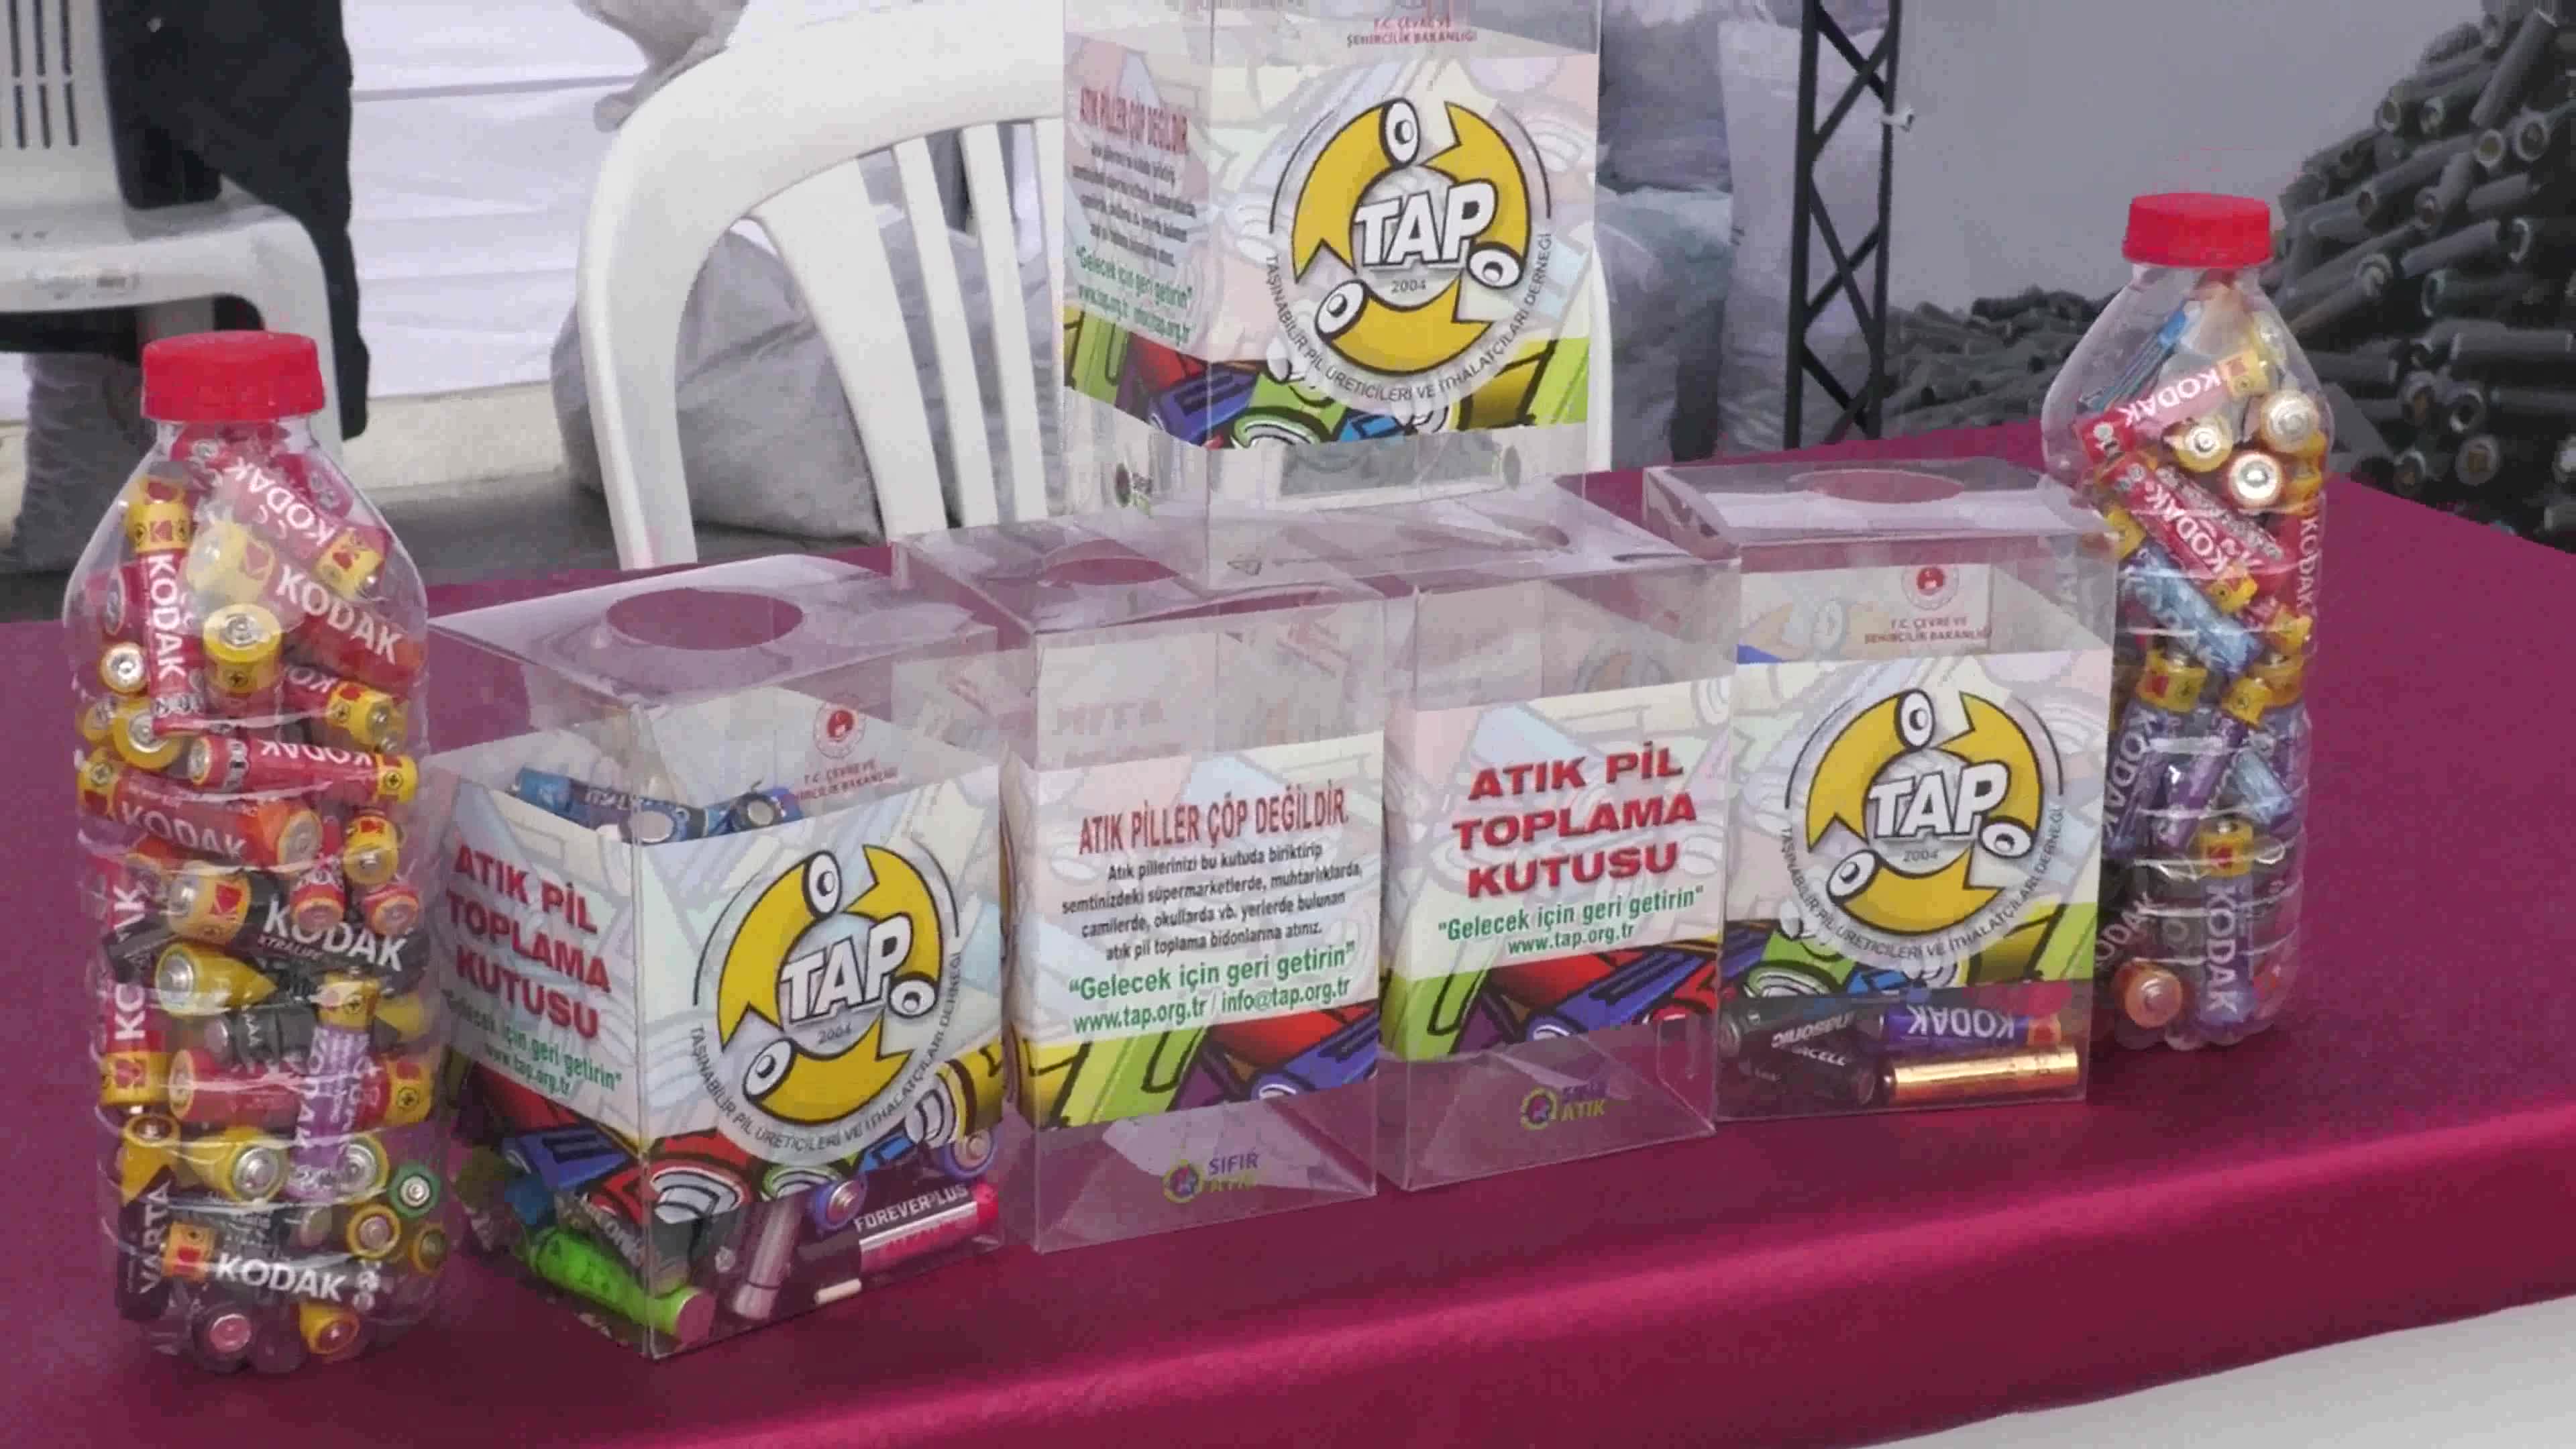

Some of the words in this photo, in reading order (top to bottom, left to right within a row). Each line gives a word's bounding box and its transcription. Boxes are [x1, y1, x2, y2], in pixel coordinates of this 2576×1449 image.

[1354, 178, 1497, 266] TAP
[1391, 278, 1428, 294] 2004
[1416, 385, 1437, 399] VE
[2117, 367, 2222, 427] KODAK
[225, 455, 337, 548] KODAK
[2295, 517, 2322, 611] KODAK
[146, 553, 186, 683] KODAK
[274, 562, 407, 668] KODAK
[1468, 755, 1587, 801] ATIK
[1605, 740, 1684, 785] PİL
[1868, 760, 2011, 838] TAP
[1079, 812, 1124, 855] ATIK
[1130, 799, 1200, 848] PİLLER
[1208, 791, 1248, 848] ÇÖP
[1452, 791, 1697, 851] TOPLAMA
[1108, 864, 1134, 881] Atık
[1137, 858, 1198, 881] pillerinizi
[1201, 855, 1218, 871] bu
[1220, 848, 1265, 868] kutuda
[1268, 842, 1324, 863] biriktirip
[1467, 841, 1678, 899] KUTUSU
[1902, 848, 1939, 863] 2004
[453, 844, 530, 906] ATIK
[541, 881, 598, 934] PİL
[1061, 889, 1144, 914] semtinizdeki
[1153, 909, 1216, 928] okullarda
[1241, 898, 1295, 921] yerlerde
[1297, 890, 1346, 910] bulunan
[1538, 903, 1576, 928] için
[1582, 896, 1622, 927] geri
[445, 888, 611, 994] TOPLAMA
[778, 912, 915, 1024] TAP
[1106, 943, 1132, 962] atık
[1134, 939, 1152, 961] pil
[1153, 934, 1208, 959] toplama
[1507, 922, 1635, 955] www.tap.org.tr
[2204, 884, 2239, 1014] KODAK
[456, 945, 600, 1040] KUTUSU
[1179, 963, 1222, 991] için
[1226, 956, 1269, 990] geri
[816, 1023, 854, 1046] 2004
[1073, 997, 1208, 1034] www.tap.org.tr
[1221, 977, 1350, 1014] info@tap.org.tr
[1907, 1005, 2016, 1040] KODAK
[139, 1179, 172, 1294] VARTA
[215, 1251, 347, 1302] KODAK
